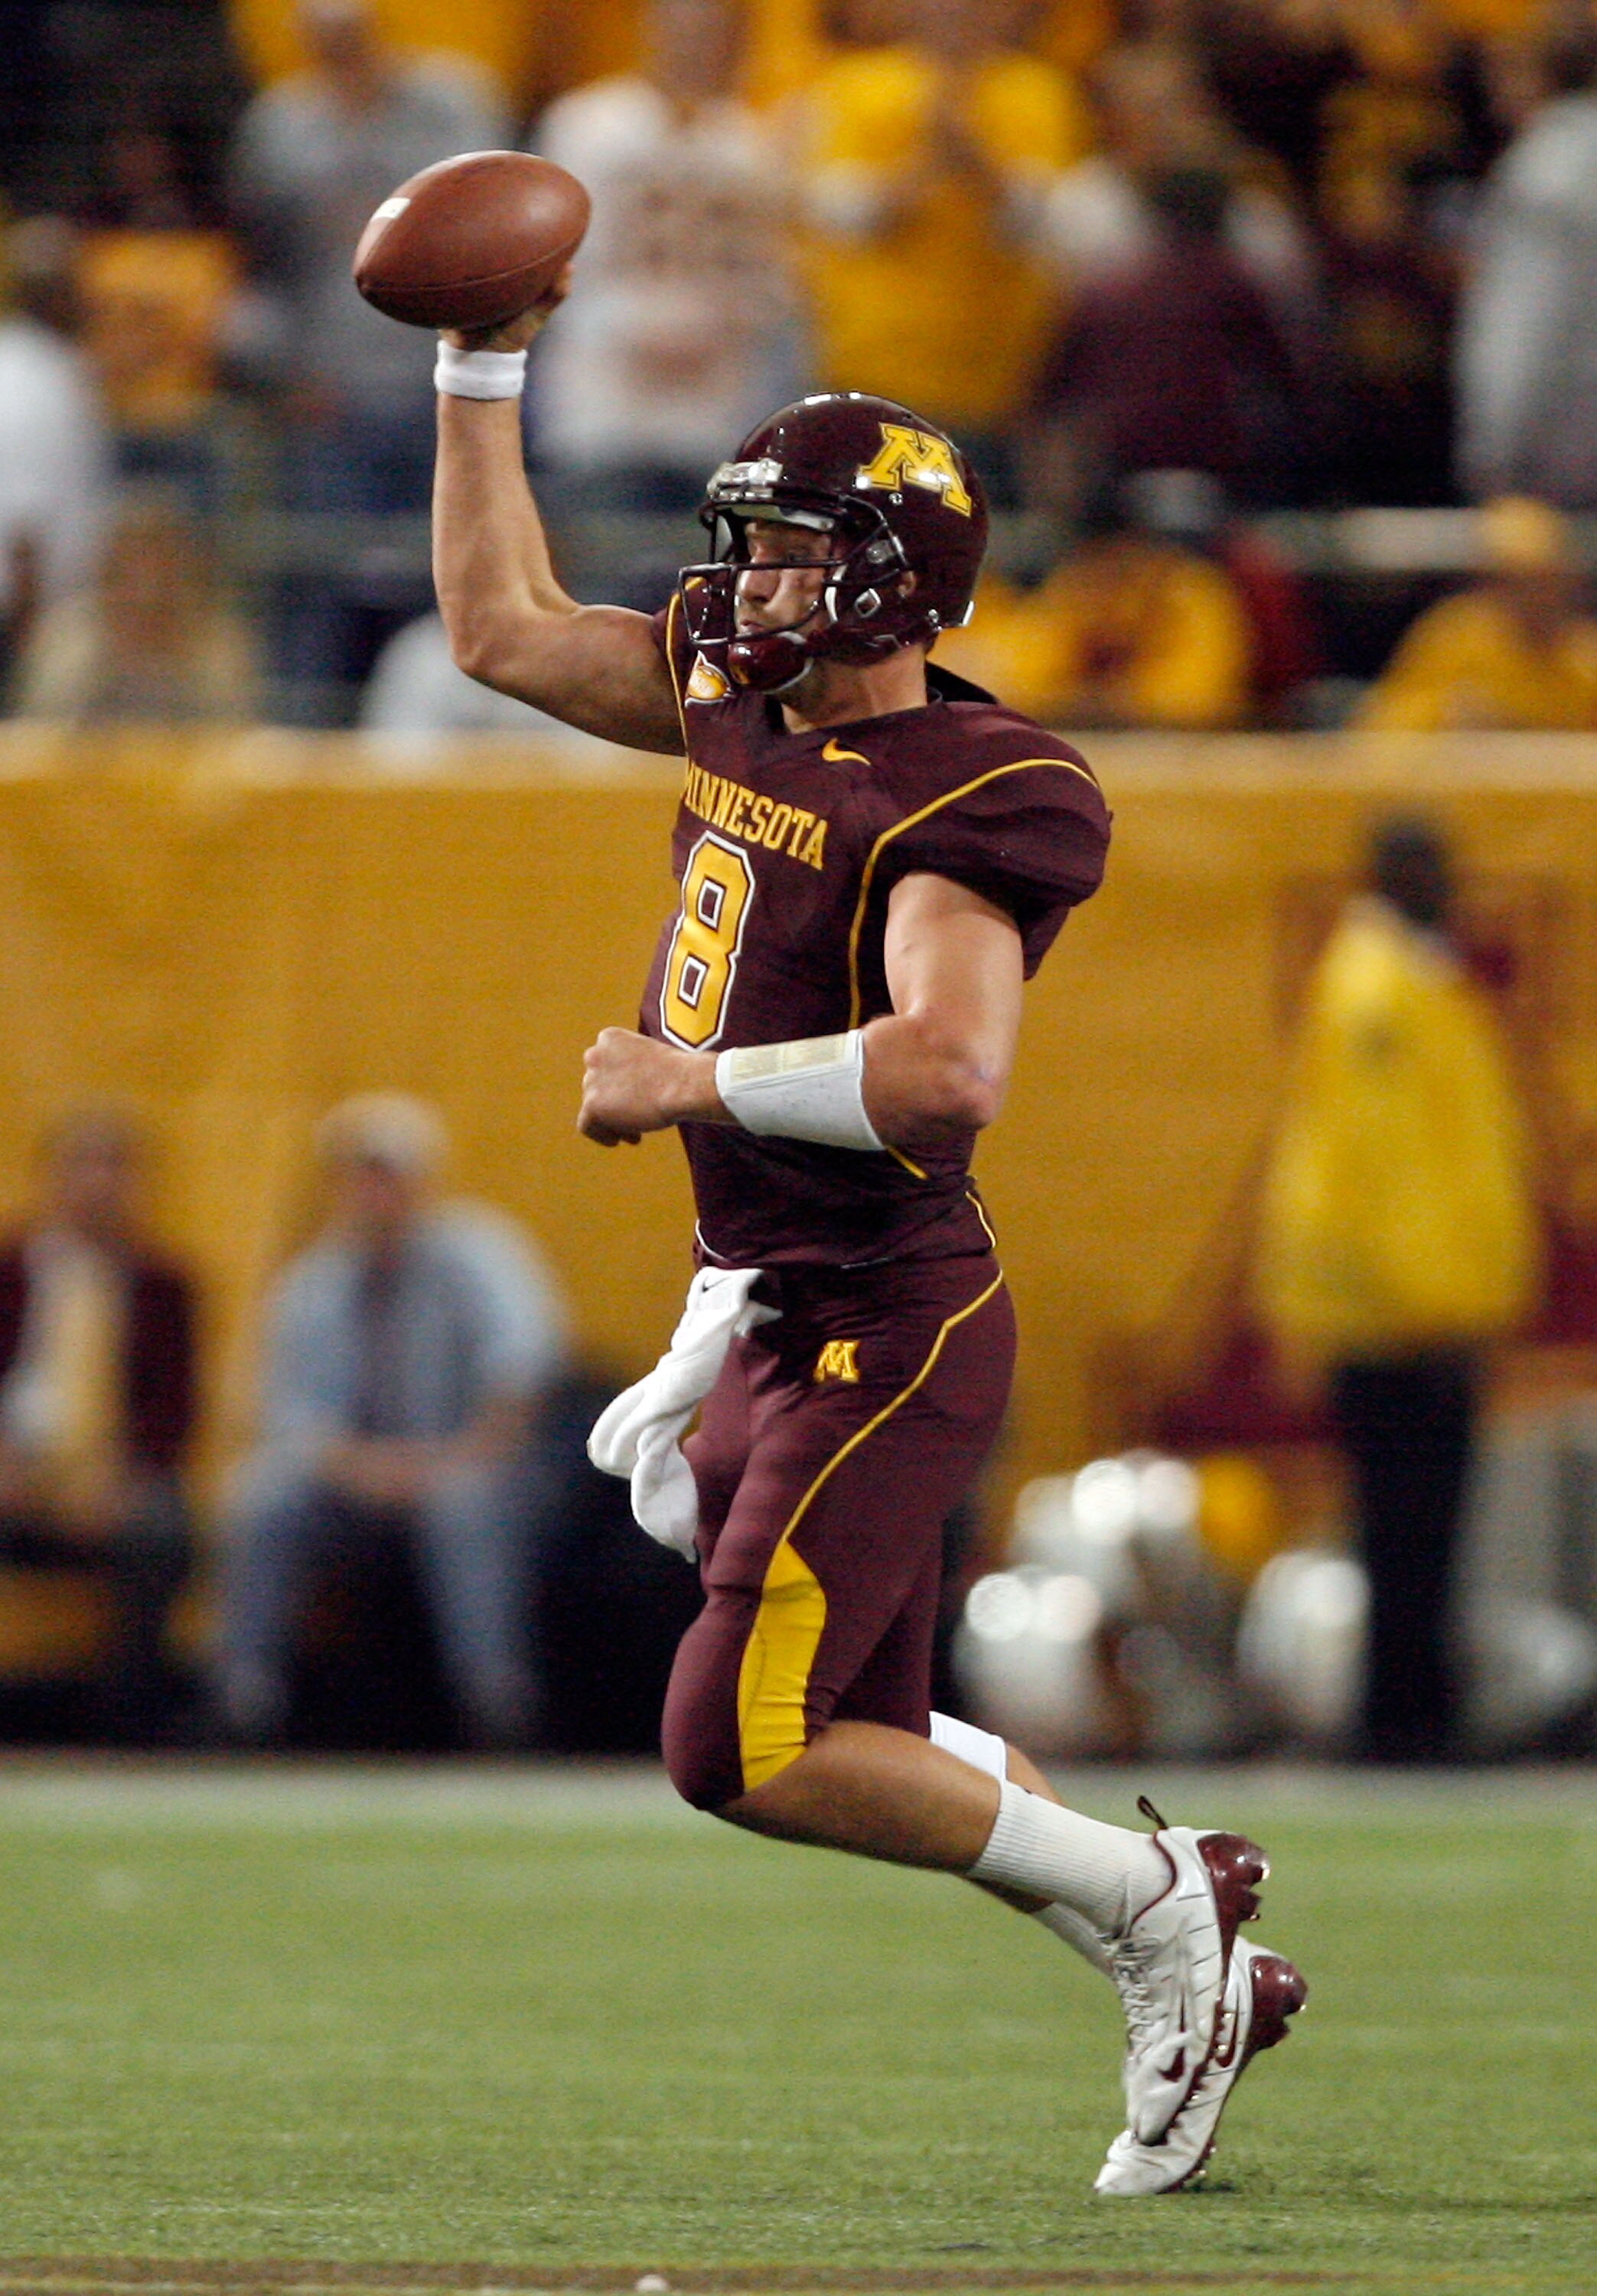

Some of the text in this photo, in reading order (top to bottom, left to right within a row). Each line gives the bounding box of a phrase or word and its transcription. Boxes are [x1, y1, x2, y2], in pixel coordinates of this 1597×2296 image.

[852, 422, 972, 518] M
[660, 830, 756, 1053] 8
[813, 1339, 859, 1383] M
